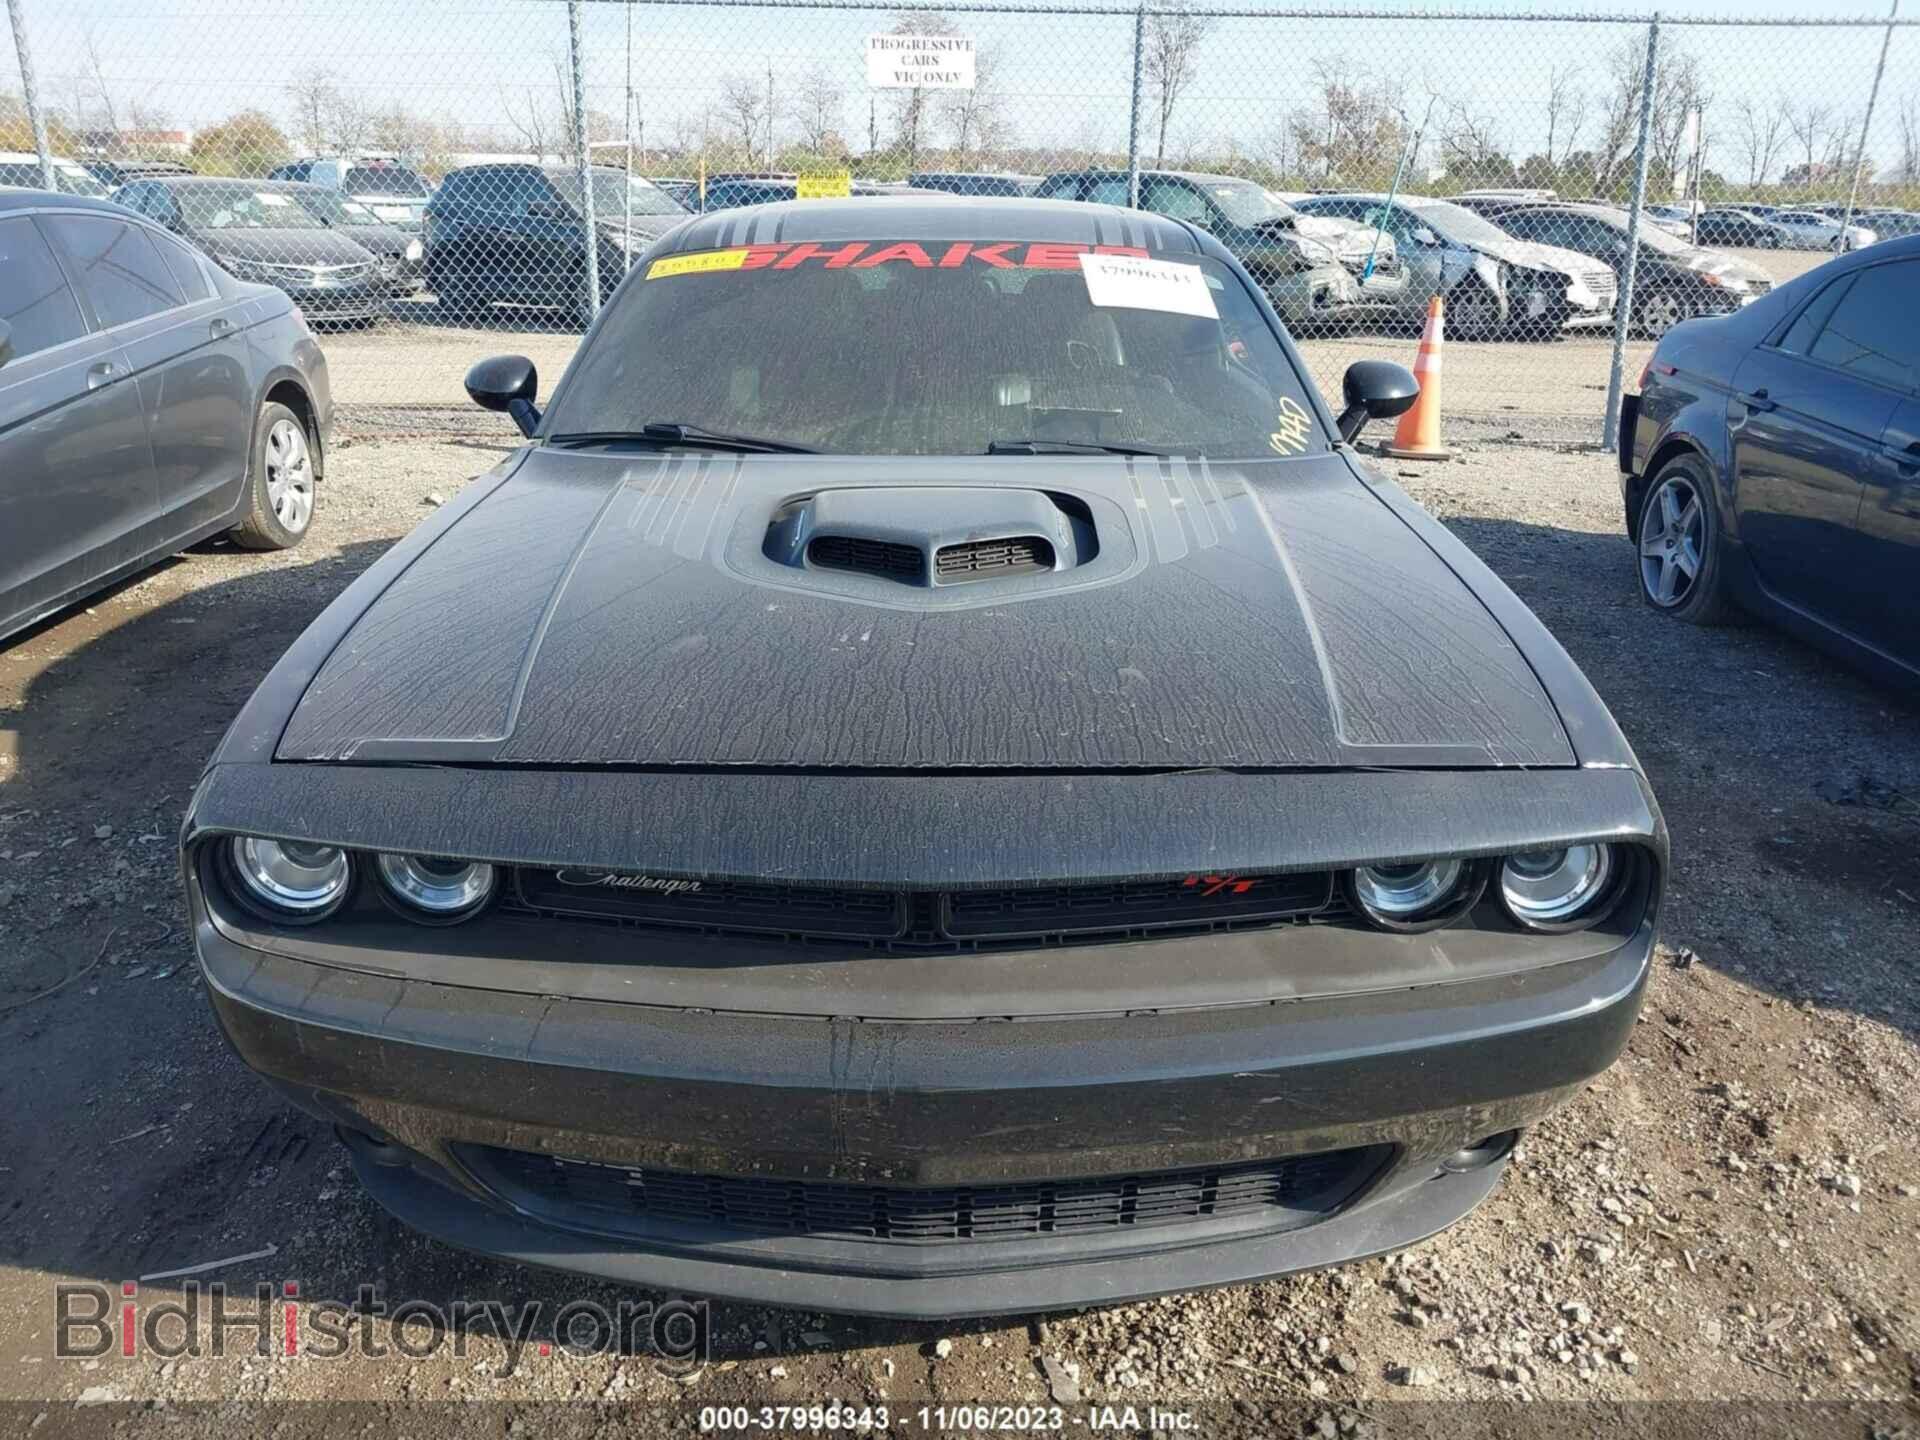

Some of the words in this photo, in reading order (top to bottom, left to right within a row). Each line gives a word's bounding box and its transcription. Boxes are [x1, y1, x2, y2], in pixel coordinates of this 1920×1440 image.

[871, 37, 974, 52] PROGRESSIVE
[901, 54, 940, 67] CARS
[894, 71, 919, 83] VIC
[923, 71, 961, 84] ONLY
[556, 869, 702, 896] Challenger
